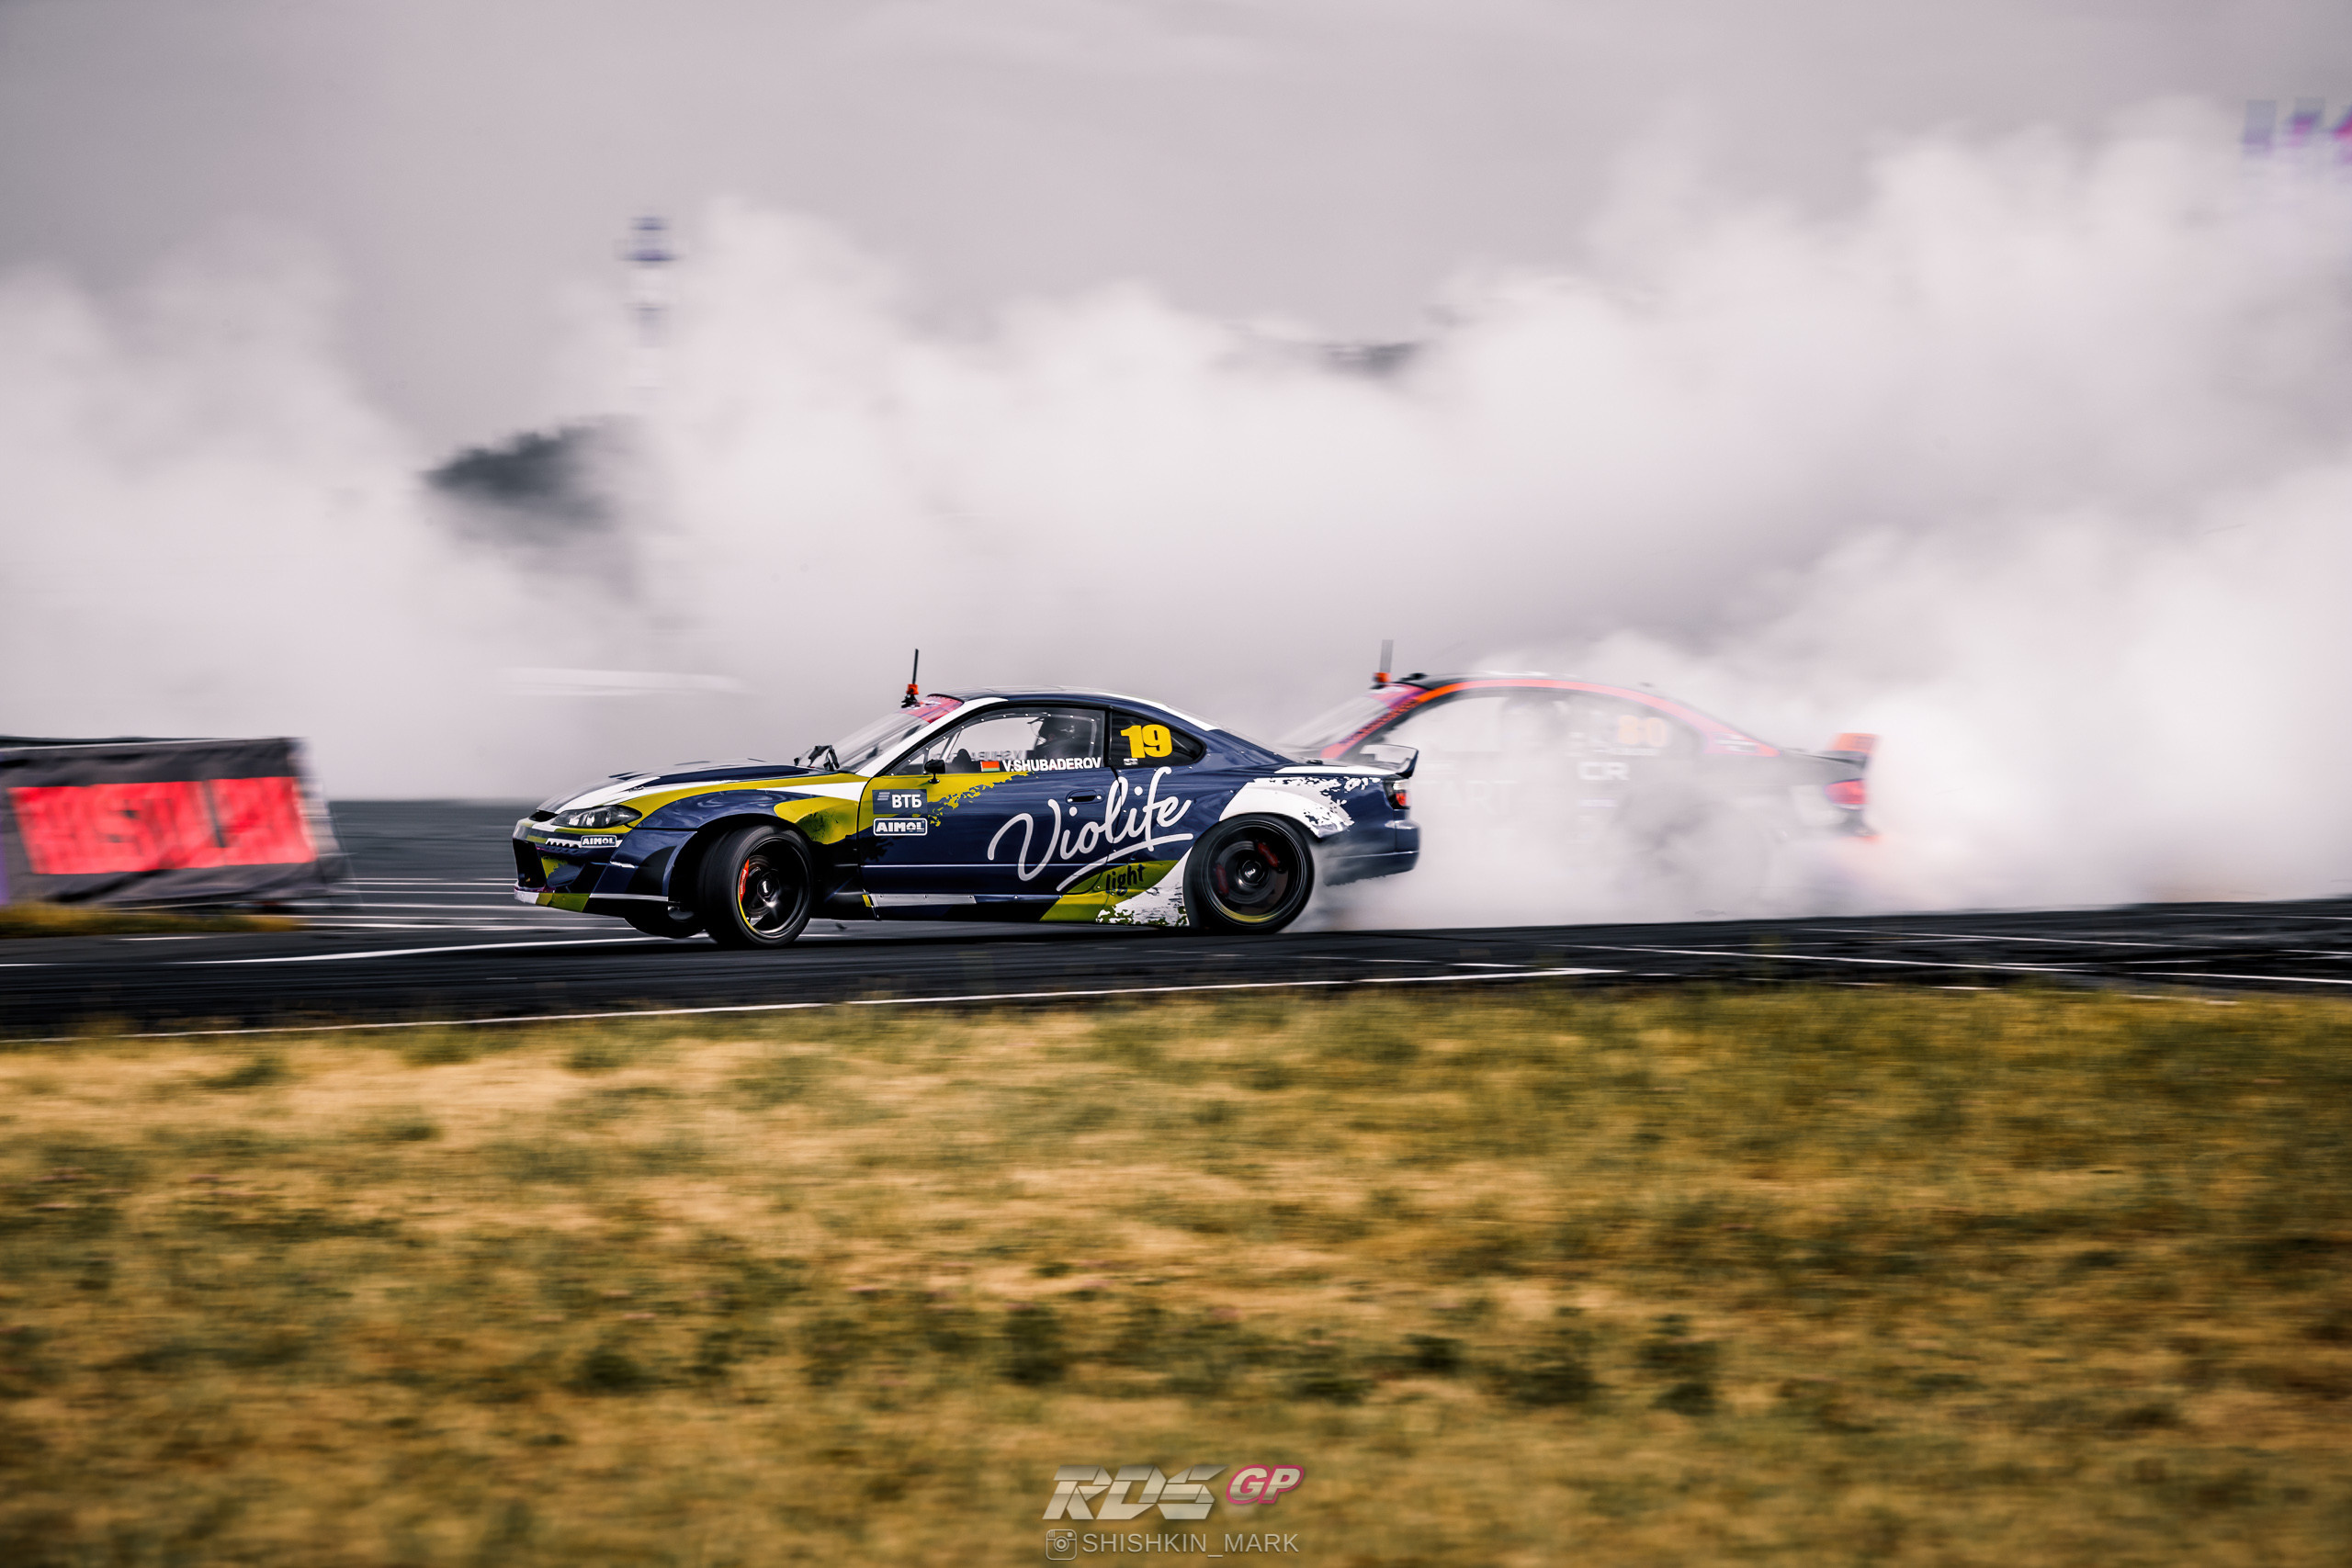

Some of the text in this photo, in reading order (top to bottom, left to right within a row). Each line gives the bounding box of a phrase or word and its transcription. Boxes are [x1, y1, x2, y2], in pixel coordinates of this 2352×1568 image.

[1120, 724, 1173, 759] 19
[1002, 757, 1102, 772] V.SHUBADEROV
[891, 794, 922, 808] ВТБ
[876, 821, 925, 832] AIMOL
[987, 766, 1193, 882] Violife
[582, 837, 616, 845] AIMOL
[1105, 864, 1146, 897] light
